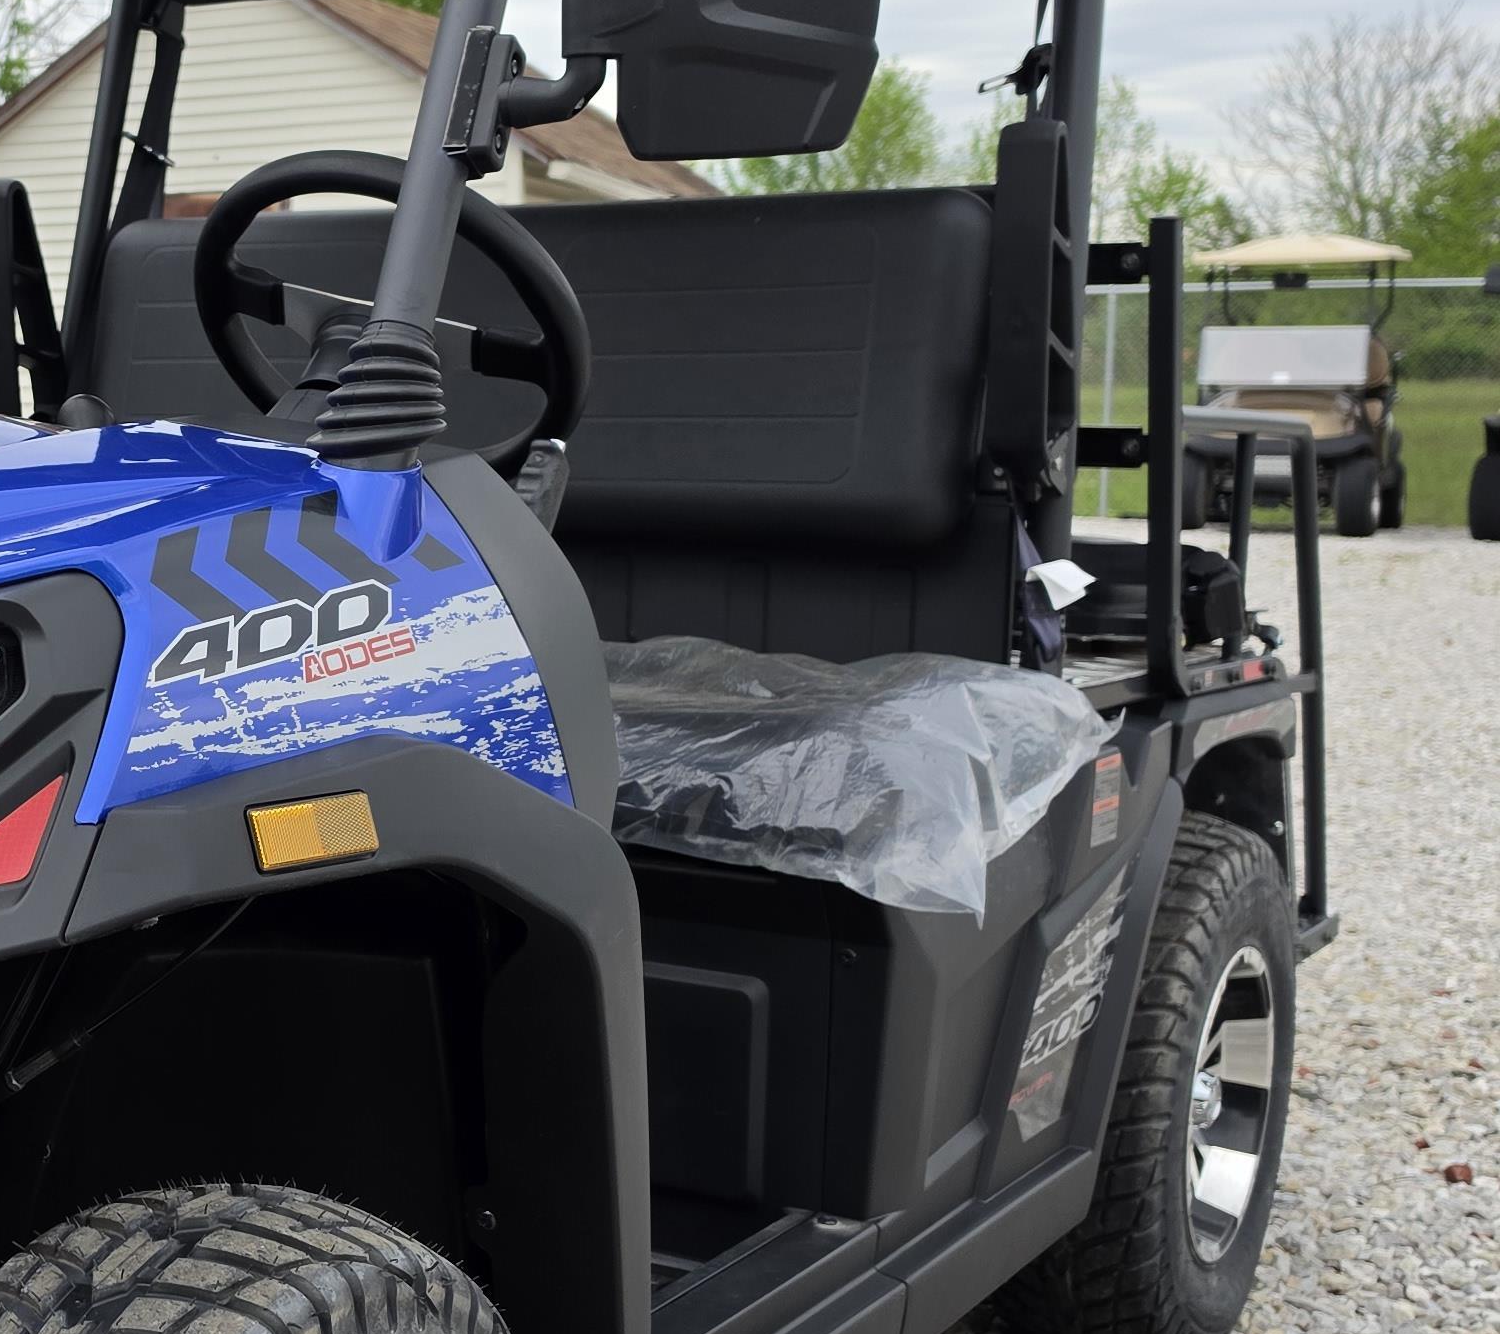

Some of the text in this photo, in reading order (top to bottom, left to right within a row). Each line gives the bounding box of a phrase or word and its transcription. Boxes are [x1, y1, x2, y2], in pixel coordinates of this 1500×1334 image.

[148, 578, 392, 686] 400
[303, 628, 416, 684] AODES
[1020, 990, 1104, 1069] 400
